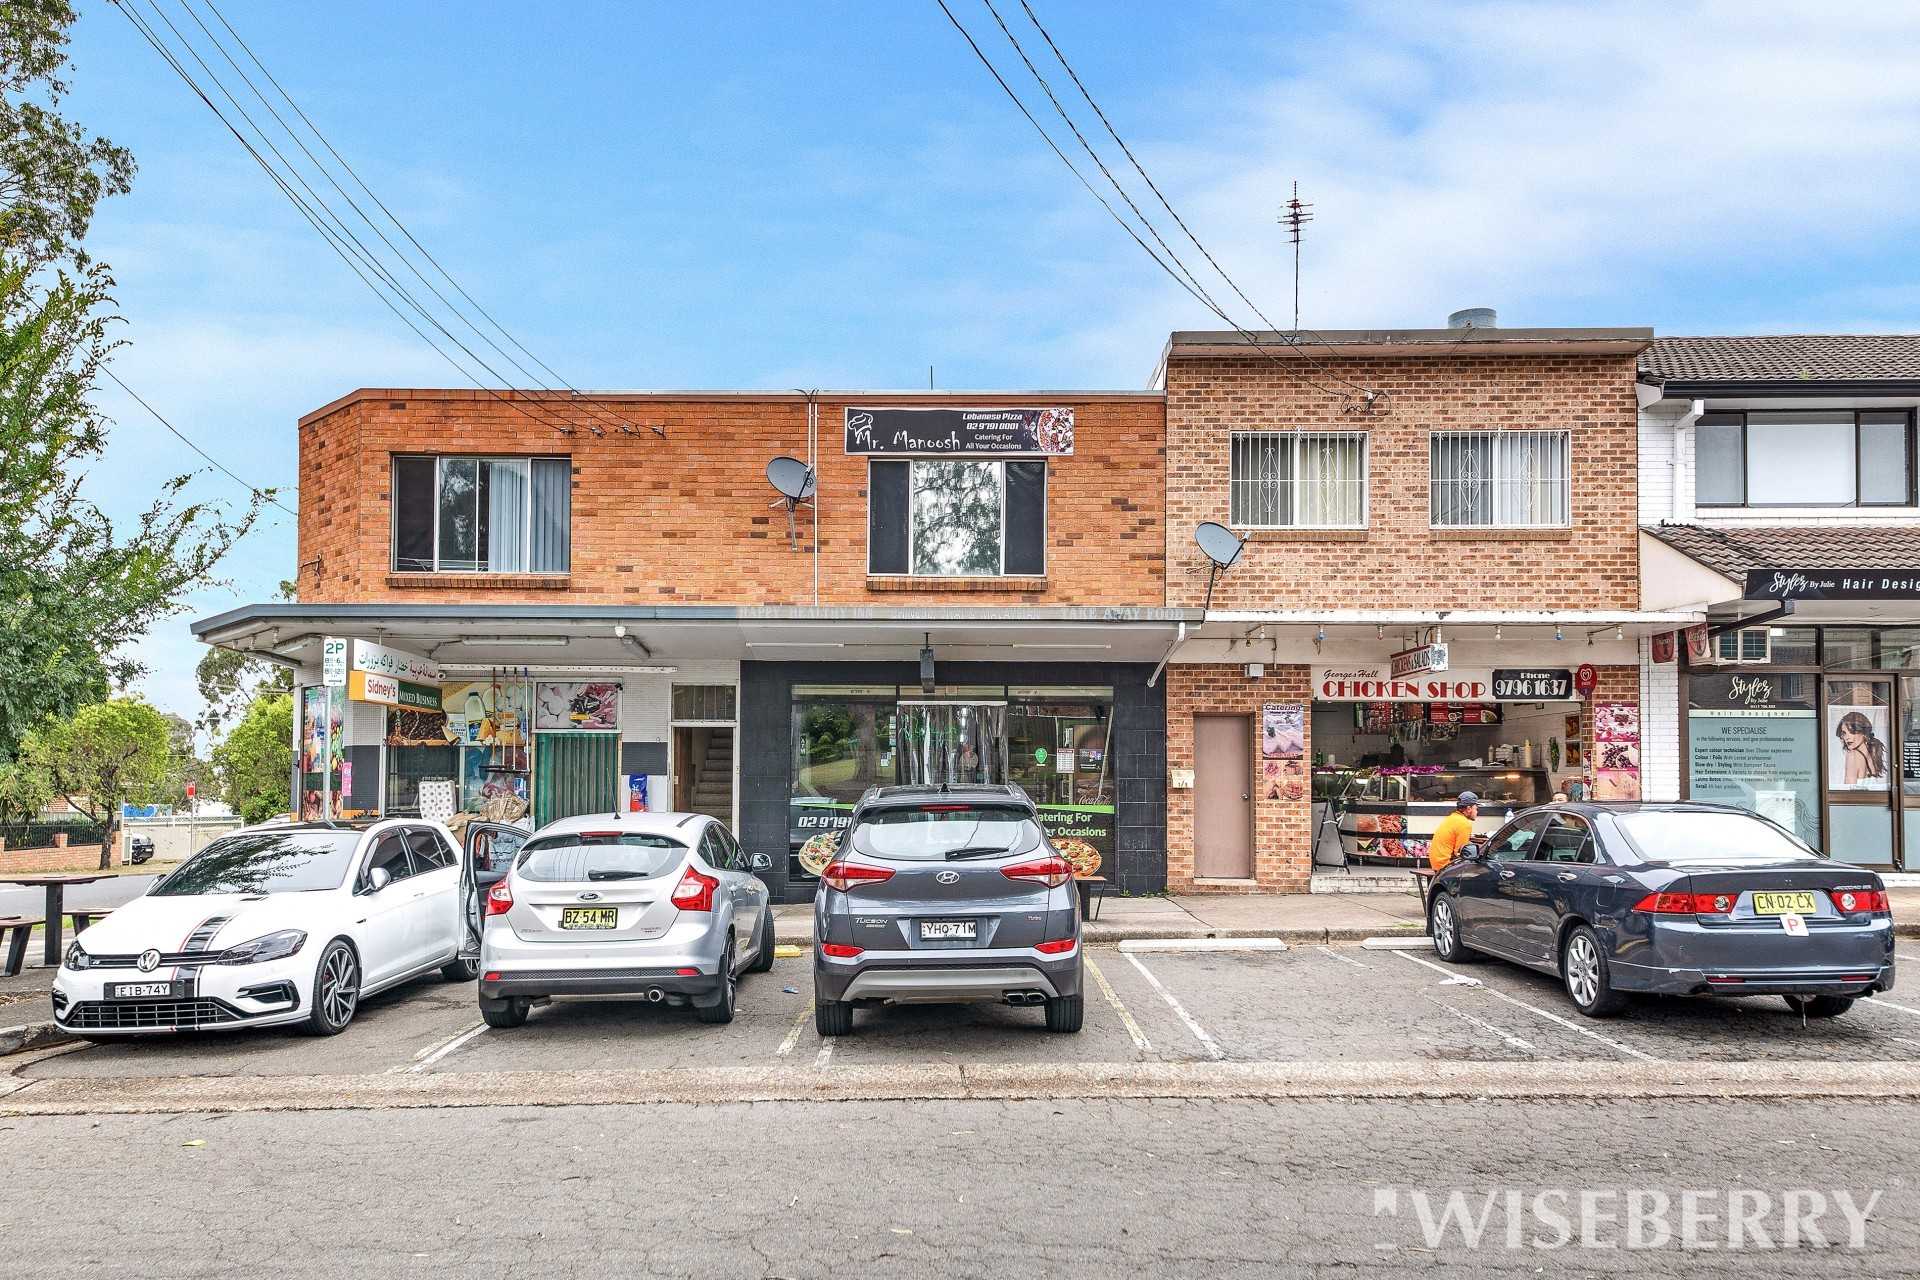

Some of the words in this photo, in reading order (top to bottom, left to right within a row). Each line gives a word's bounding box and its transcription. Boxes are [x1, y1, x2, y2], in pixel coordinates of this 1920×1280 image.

[962, 412, 1001, 421] Lebanese
[1001, 412, 1023, 421] Pizza
[966, 422, 978, 430] 02
[978, 422, 999, 430] 9791
[998, 422, 1019, 430] 0001
[856, 429, 885, 451] Mr.
[893, 430, 961, 451] Manoosh
[974, 433, 1001, 442] Catering
[1002, 433, 1013, 441] For
[990, 442, 1022, 450] Occasions
[1810, 580, 1819, 589] By
[1819, 580, 1836, 588] Julie
[1842, 578, 1874, 590] Hair
[325, 642, 345, 654] 2P
[1413, 650, 1431, 670] SALADS
[1323, 669, 1357, 680] Georges
[1357, 669, 1379, 678] Hall
[367, 679, 396, 698] Sidney's
[1322, 680, 1420, 698] CHICKEN
[1427, 681, 1487, 699] SHOP
[1495, 679, 1533, 696] 9796
[1533, 679, 1568, 696] 1637
[400, 690, 416, 703] MIXED
[416, 692, 438, 707] BUSINESS
[1265, 704, 1301, 712] Catering
[1721, 726, 1732, 734] WE
[1733, 726, 1768, 734] SPECIALISE
[797, 816, 818, 828] 02
[1037, 812, 1074, 825] atering
[1075, 812, 1093, 823] For
[1057, 826, 1107, 837] Occasions
[1787, 918, 1799, 931] P
